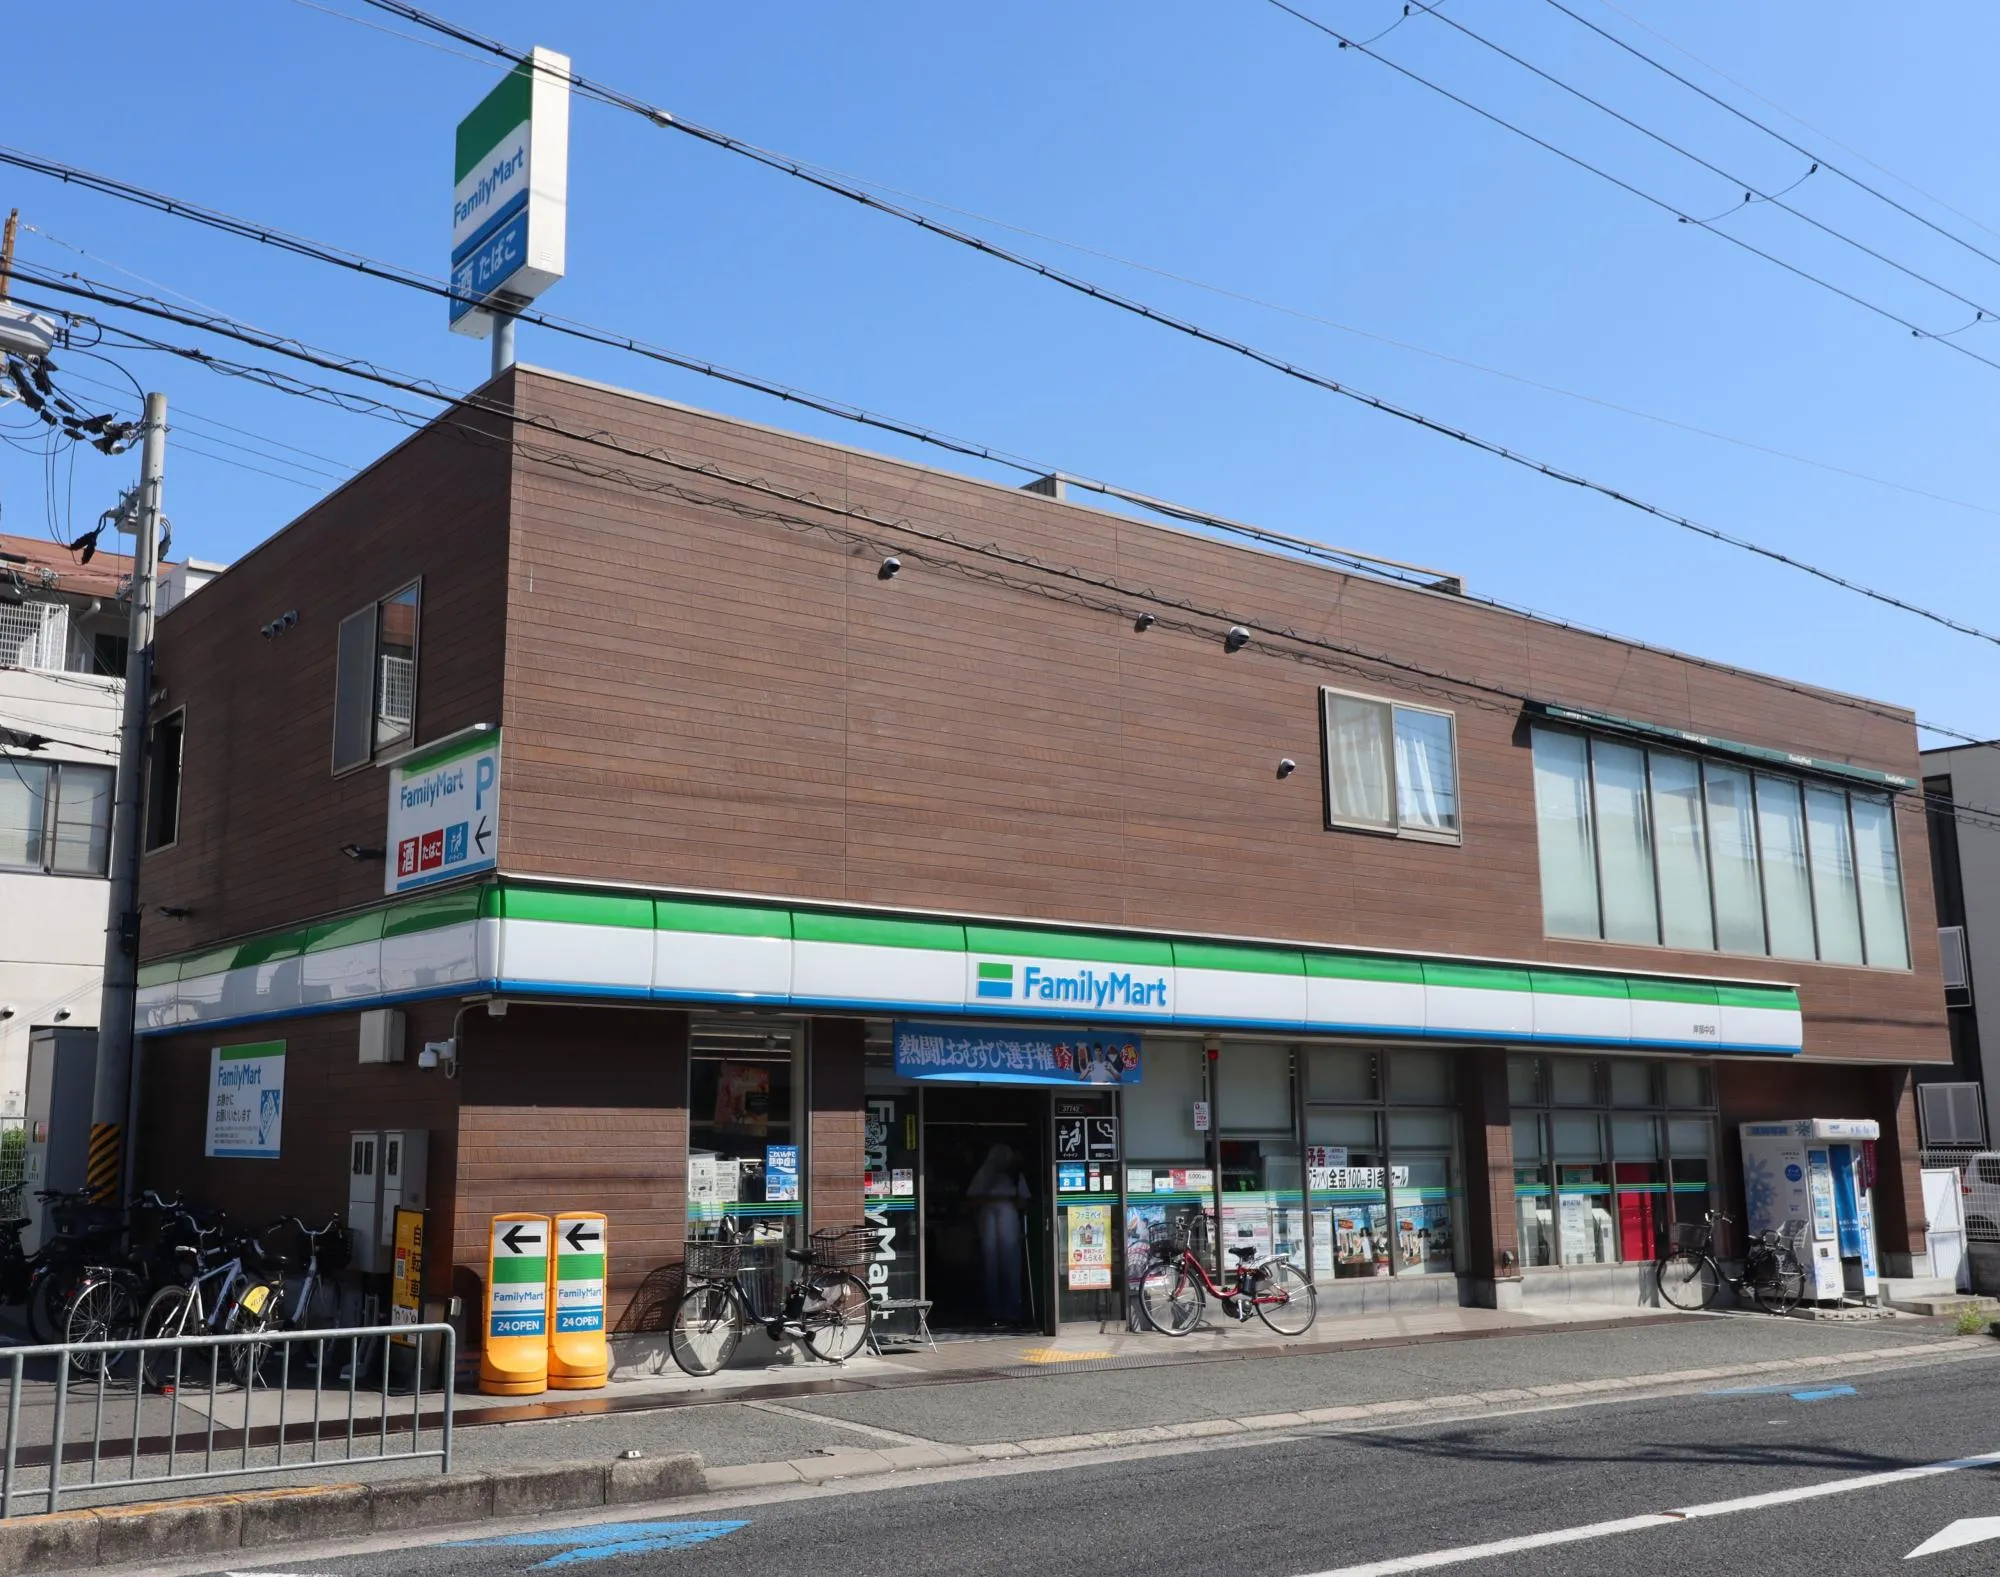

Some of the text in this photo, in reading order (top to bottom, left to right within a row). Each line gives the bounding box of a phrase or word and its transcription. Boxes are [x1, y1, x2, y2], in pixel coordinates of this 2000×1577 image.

[454, 145, 524, 229] FamilyMart
[478, 230, 517, 287] たばこ
[400, 768, 464, 811] FamilyMart
[476, 756, 494, 811] P
[402, 842, 442, 873] 酒 たばこ
[1024, 966, 1167, 1009] FamilyMart
[218, 1063, 262, 1091] FamilyMart
[216, 1108, 252, 1122] お願いいたします
[217, 1093, 235, 1107] お静かに
[1308, 1147, 1326, 1168] 予告
[864, 1101, 897, 1320] FamyMart
[493, 1291, 544, 1304] FamilyMart
[558, 1287, 602, 1299] FamilyMart
